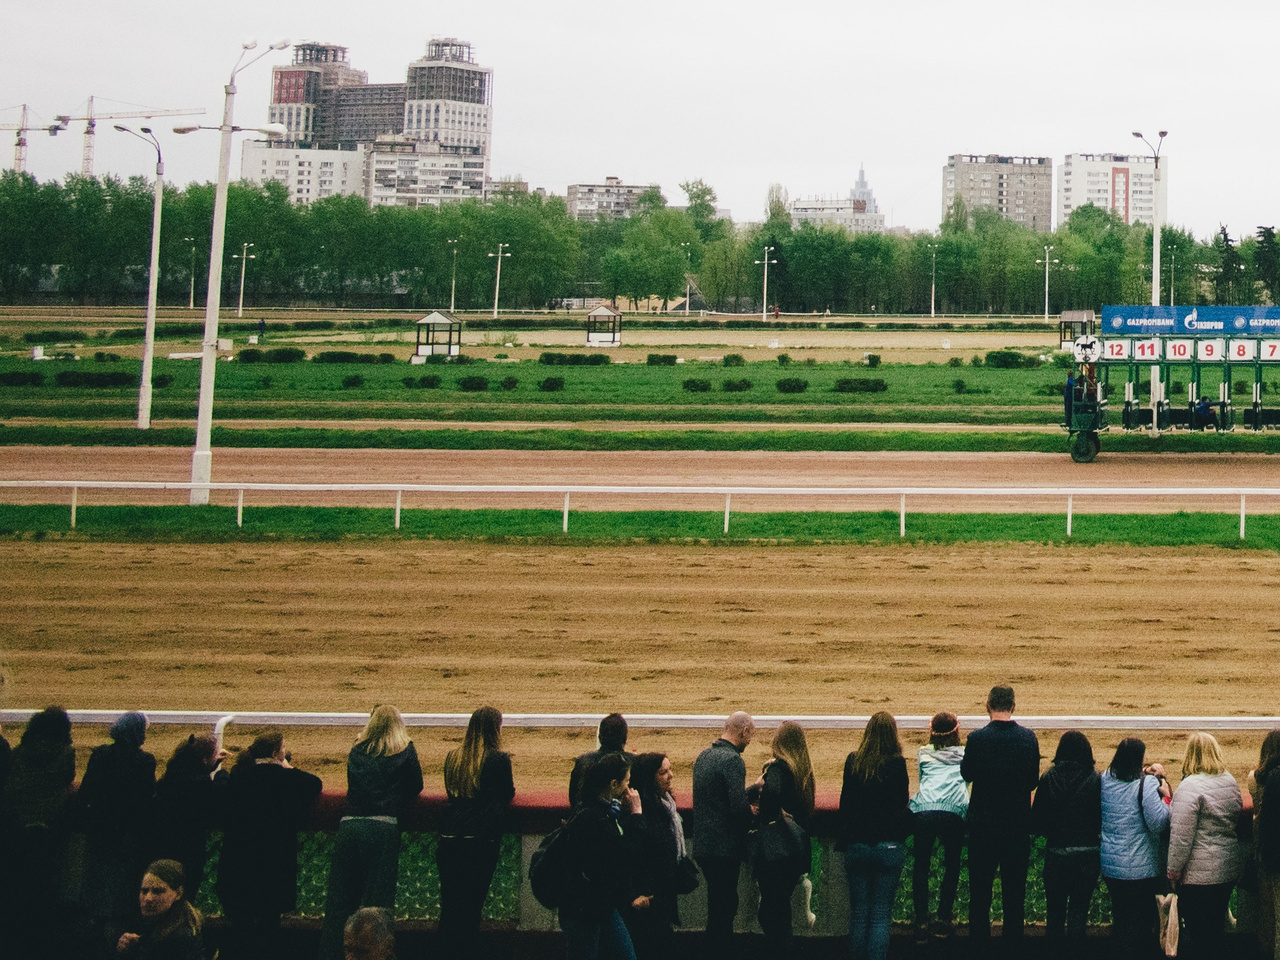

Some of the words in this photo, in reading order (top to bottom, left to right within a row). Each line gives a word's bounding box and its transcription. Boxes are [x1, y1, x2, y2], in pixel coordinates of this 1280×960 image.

[1126, 318, 1175, 326] GAZPROMBANK
[1109, 344, 1123, 356] 12
[1138, 343, 1155, 356] 11
[1171, 344, 1187, 356] 10
[1205, 344, 1214, 356] 9
[1236, 344, 1246, 357] 8
[1268, 345, 1277, 357] 7
